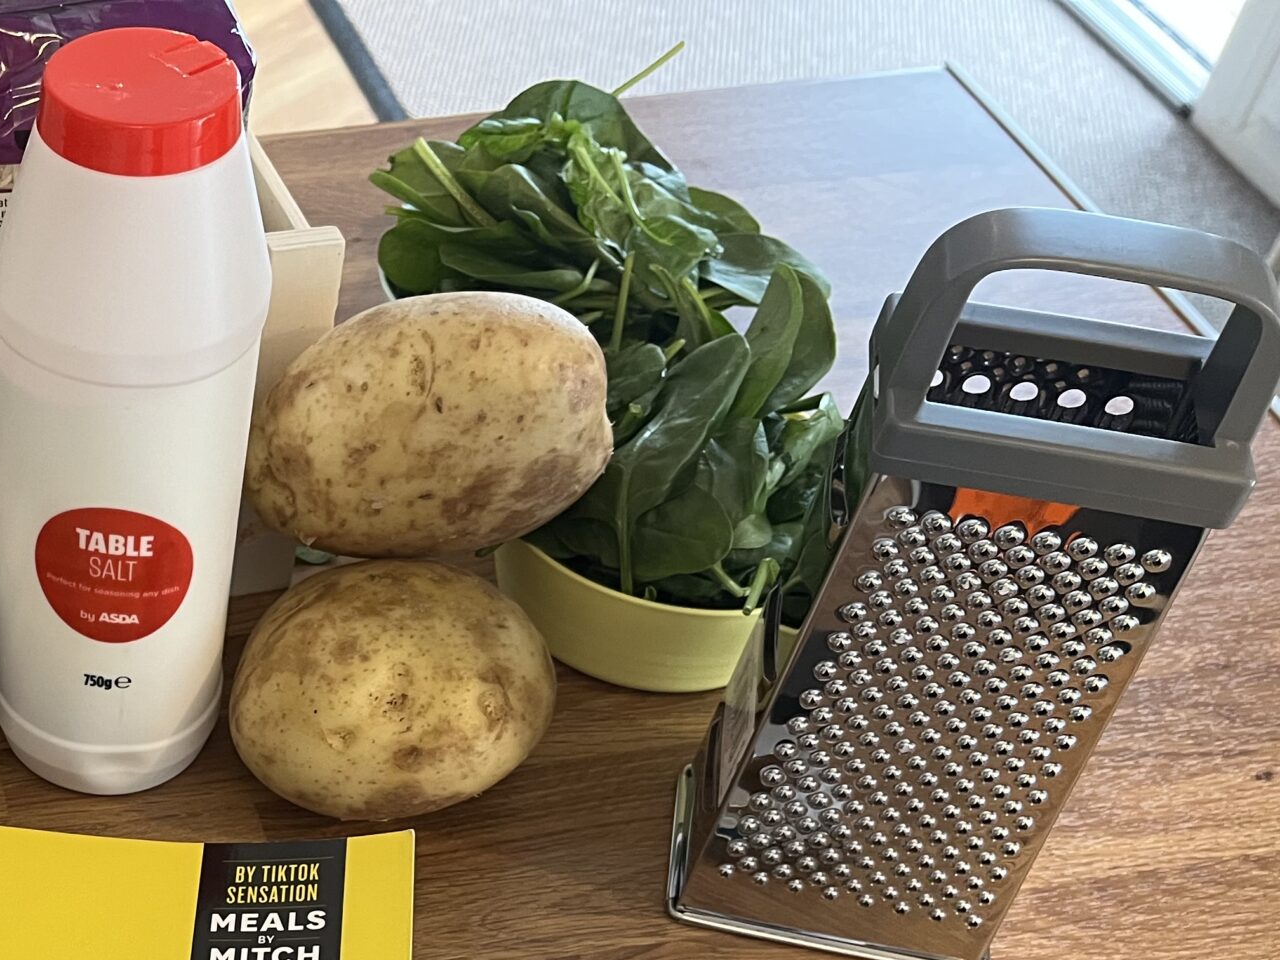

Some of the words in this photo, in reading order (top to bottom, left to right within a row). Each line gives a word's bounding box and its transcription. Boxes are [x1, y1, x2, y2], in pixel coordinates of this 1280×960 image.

[76, 527, 155, 557] TABLE
[89, 556, 138, 582] SALT
[79, 583, 91, 592] for
[94, 587, 140, 598] seasoning
[161, 586, 180, 596] dish
[80, 609, 95, 622] by
[99, 612, 140, 624] ASDA
[83, 673, 112, 690] 750g
[235, 866, 256, 884] BY
[261, 863, 320, 882] TIKTOK
[226, 884, 318, 904] SENSATION
[209, 910, 327, 932] MEALS
[257, 935, 275, 944] BY
